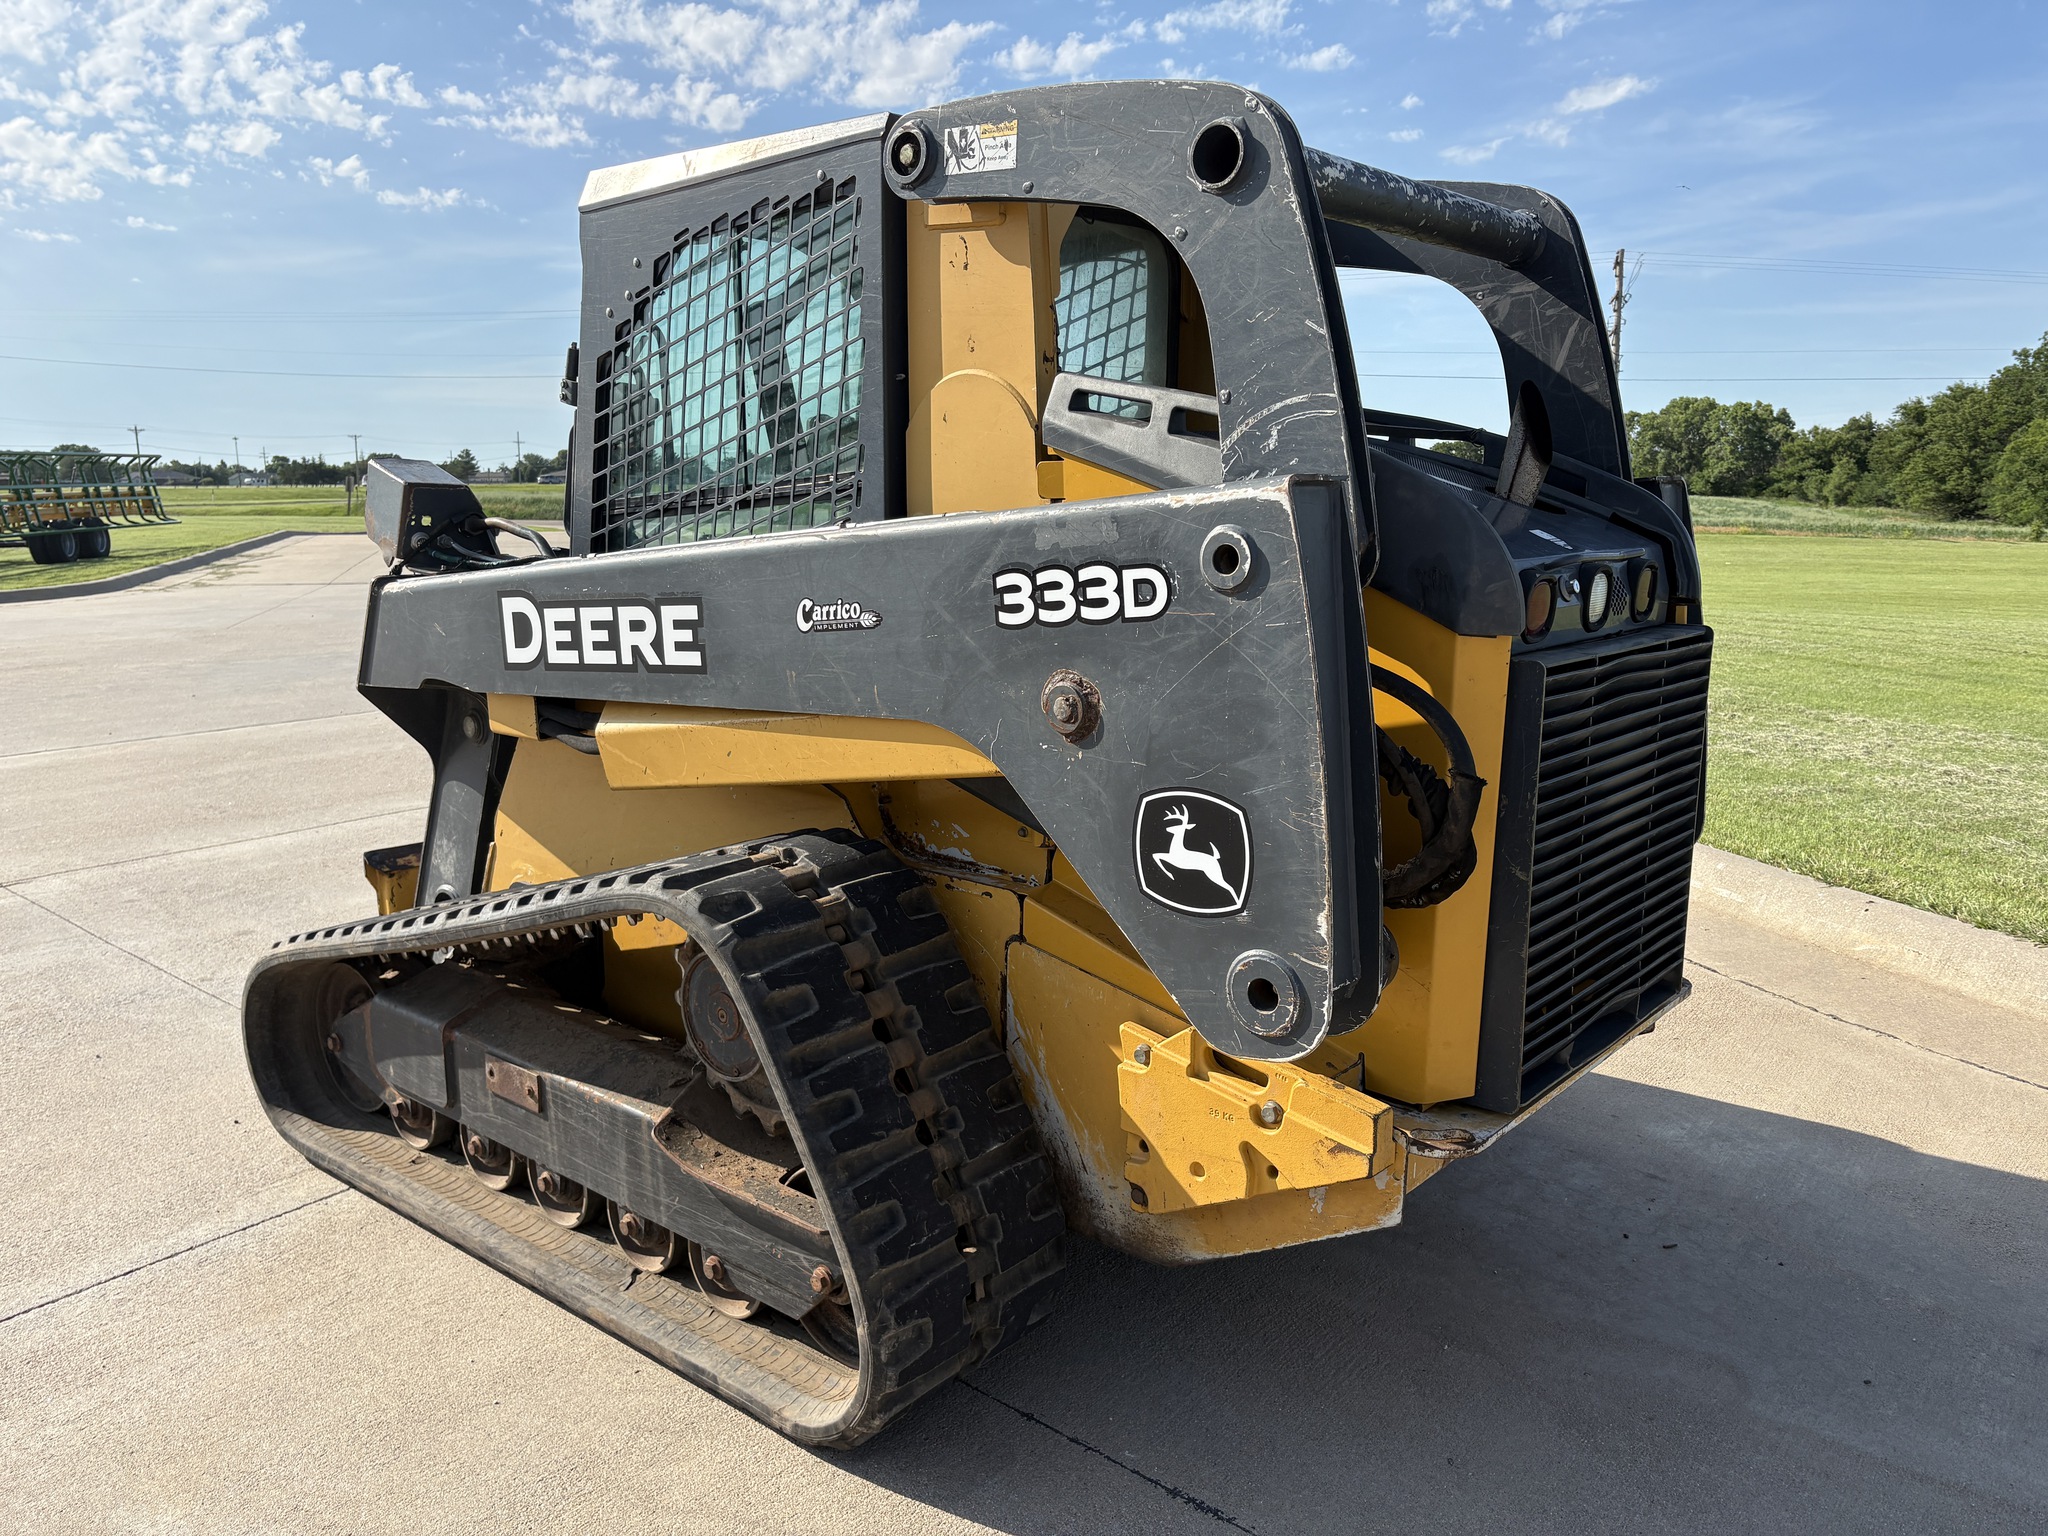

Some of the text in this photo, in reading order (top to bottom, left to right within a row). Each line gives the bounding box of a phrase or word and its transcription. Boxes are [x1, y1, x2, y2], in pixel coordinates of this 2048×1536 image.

[796, 598, 861, 632] Carrico
[995, 565, 1168, 625] 333D
[501, 597, 702, 666] DEERE
[814, 622, 859, 630] IMPLEMENT
